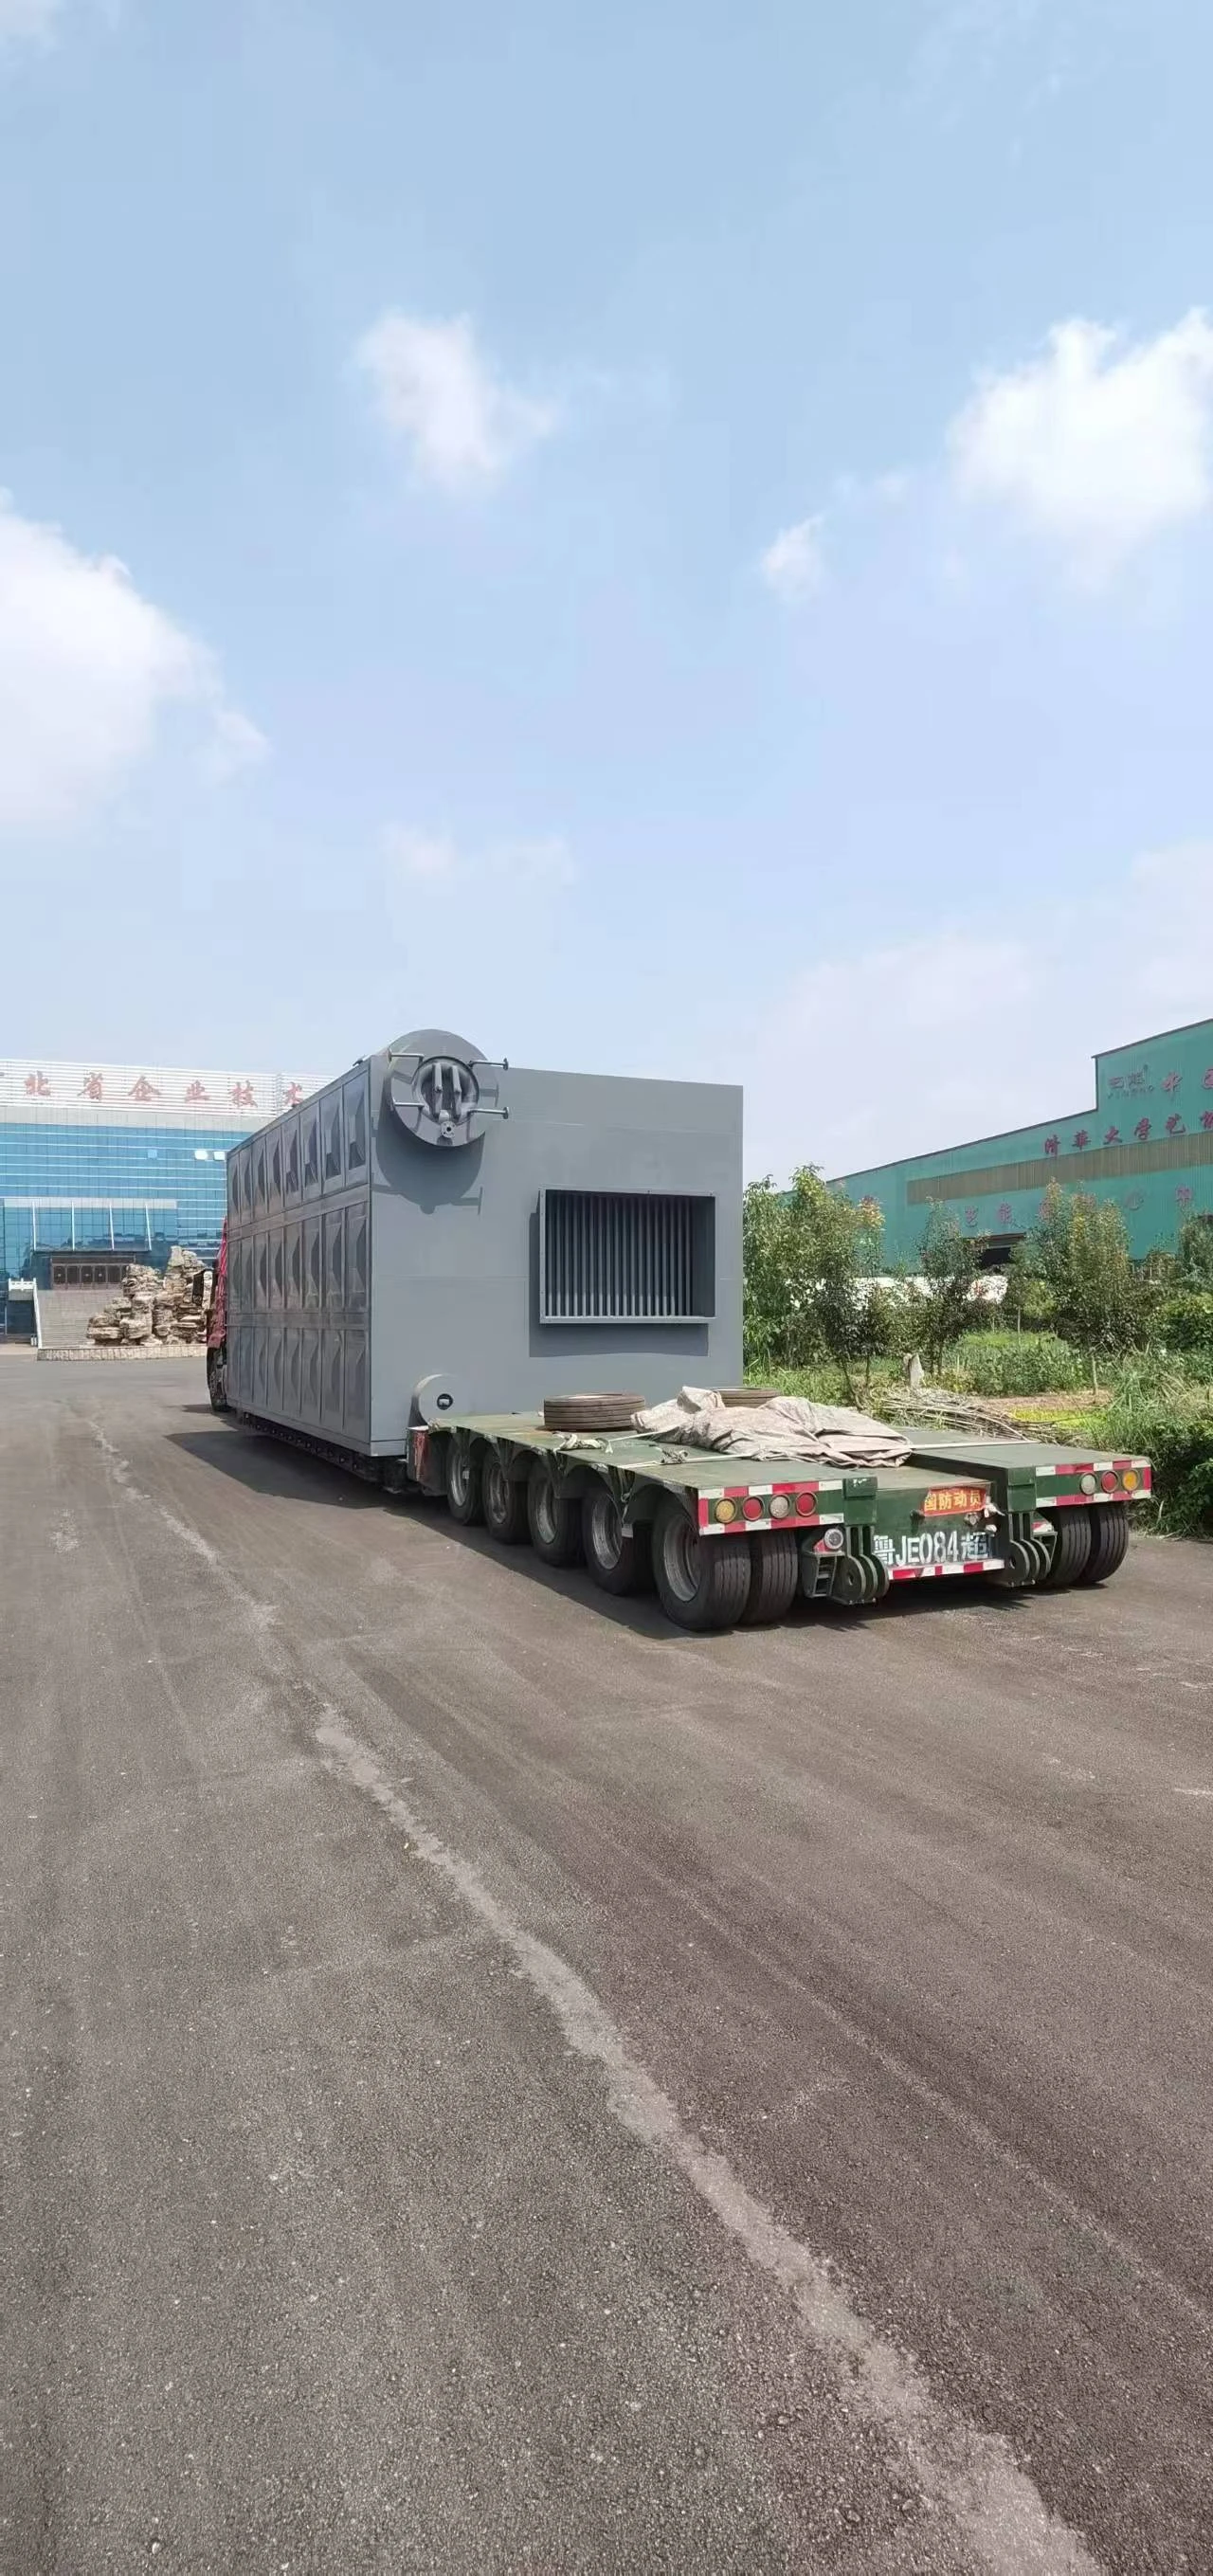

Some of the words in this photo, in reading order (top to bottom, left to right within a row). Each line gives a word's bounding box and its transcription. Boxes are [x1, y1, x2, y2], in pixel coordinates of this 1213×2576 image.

[0, 1070, 303, 1107] 北省企业技术
